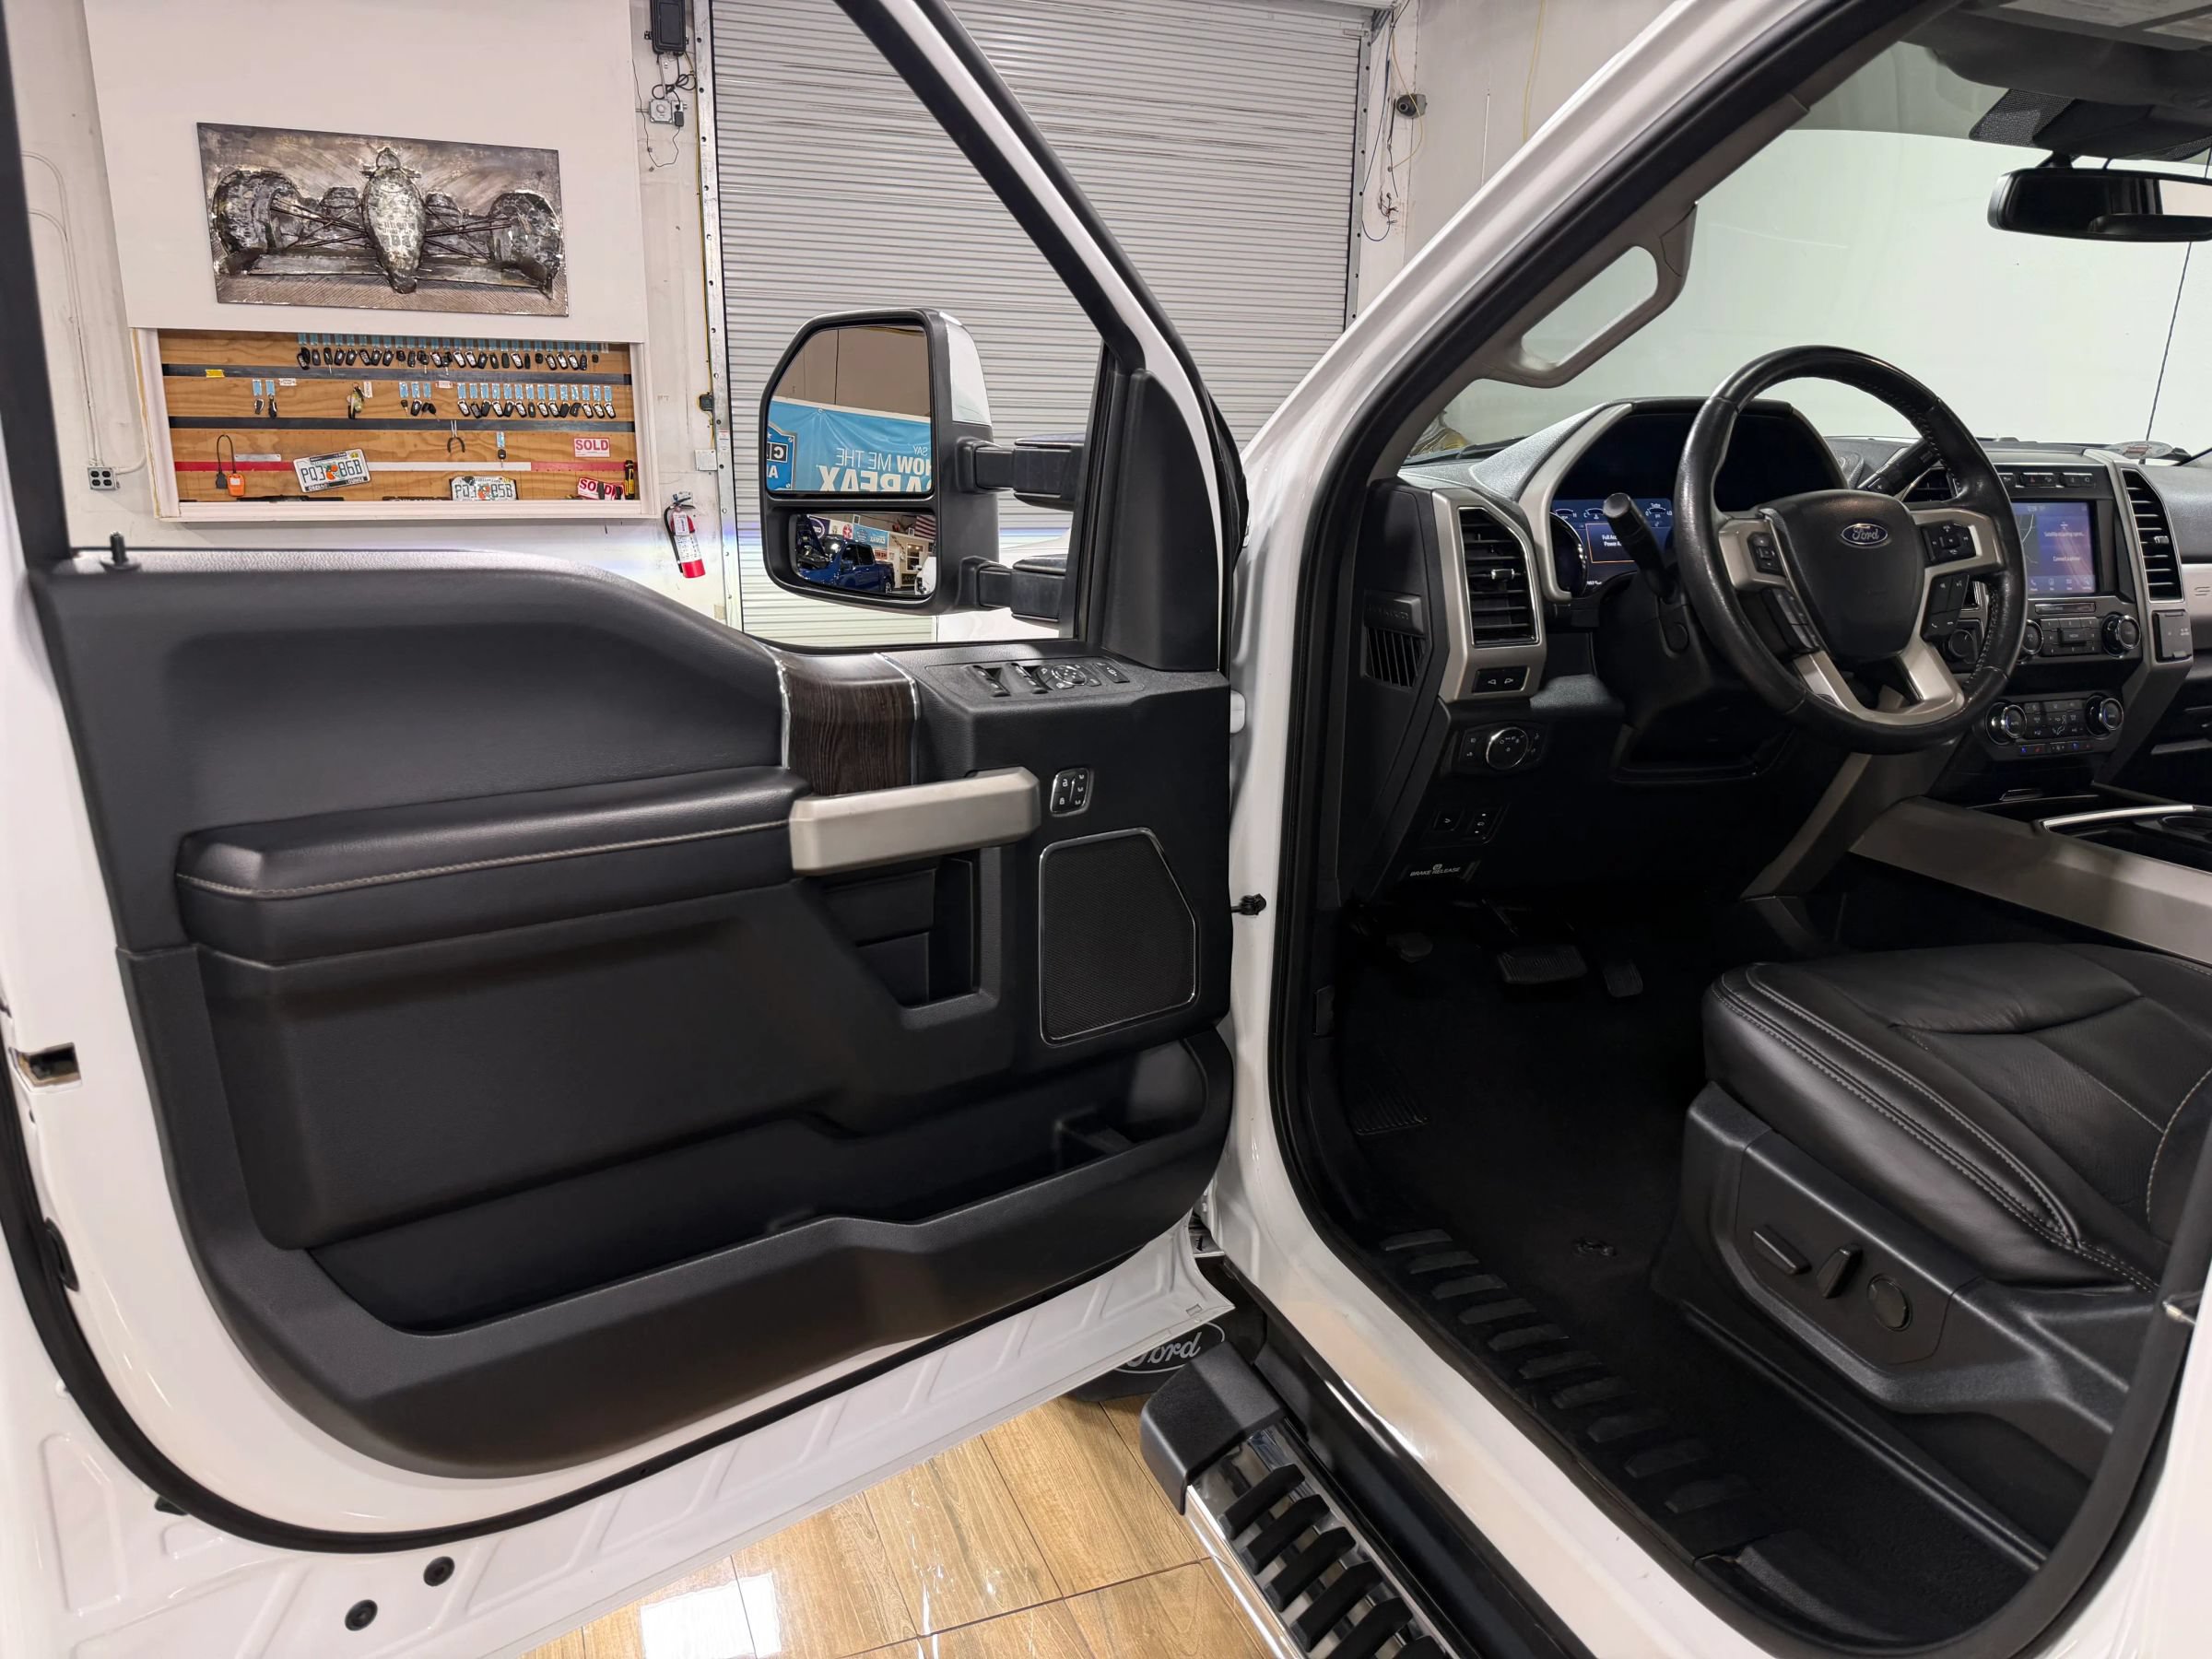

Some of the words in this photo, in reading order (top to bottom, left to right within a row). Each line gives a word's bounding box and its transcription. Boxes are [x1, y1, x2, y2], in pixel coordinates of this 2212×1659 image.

[575, 440, 608, 451] SOLD
[300, 465, 326, 483] PQ3
[337, 459, 363, 477] 86B
[579, 478, 612, 495] SOD
[1852, 526, 1879, 540] Ford
